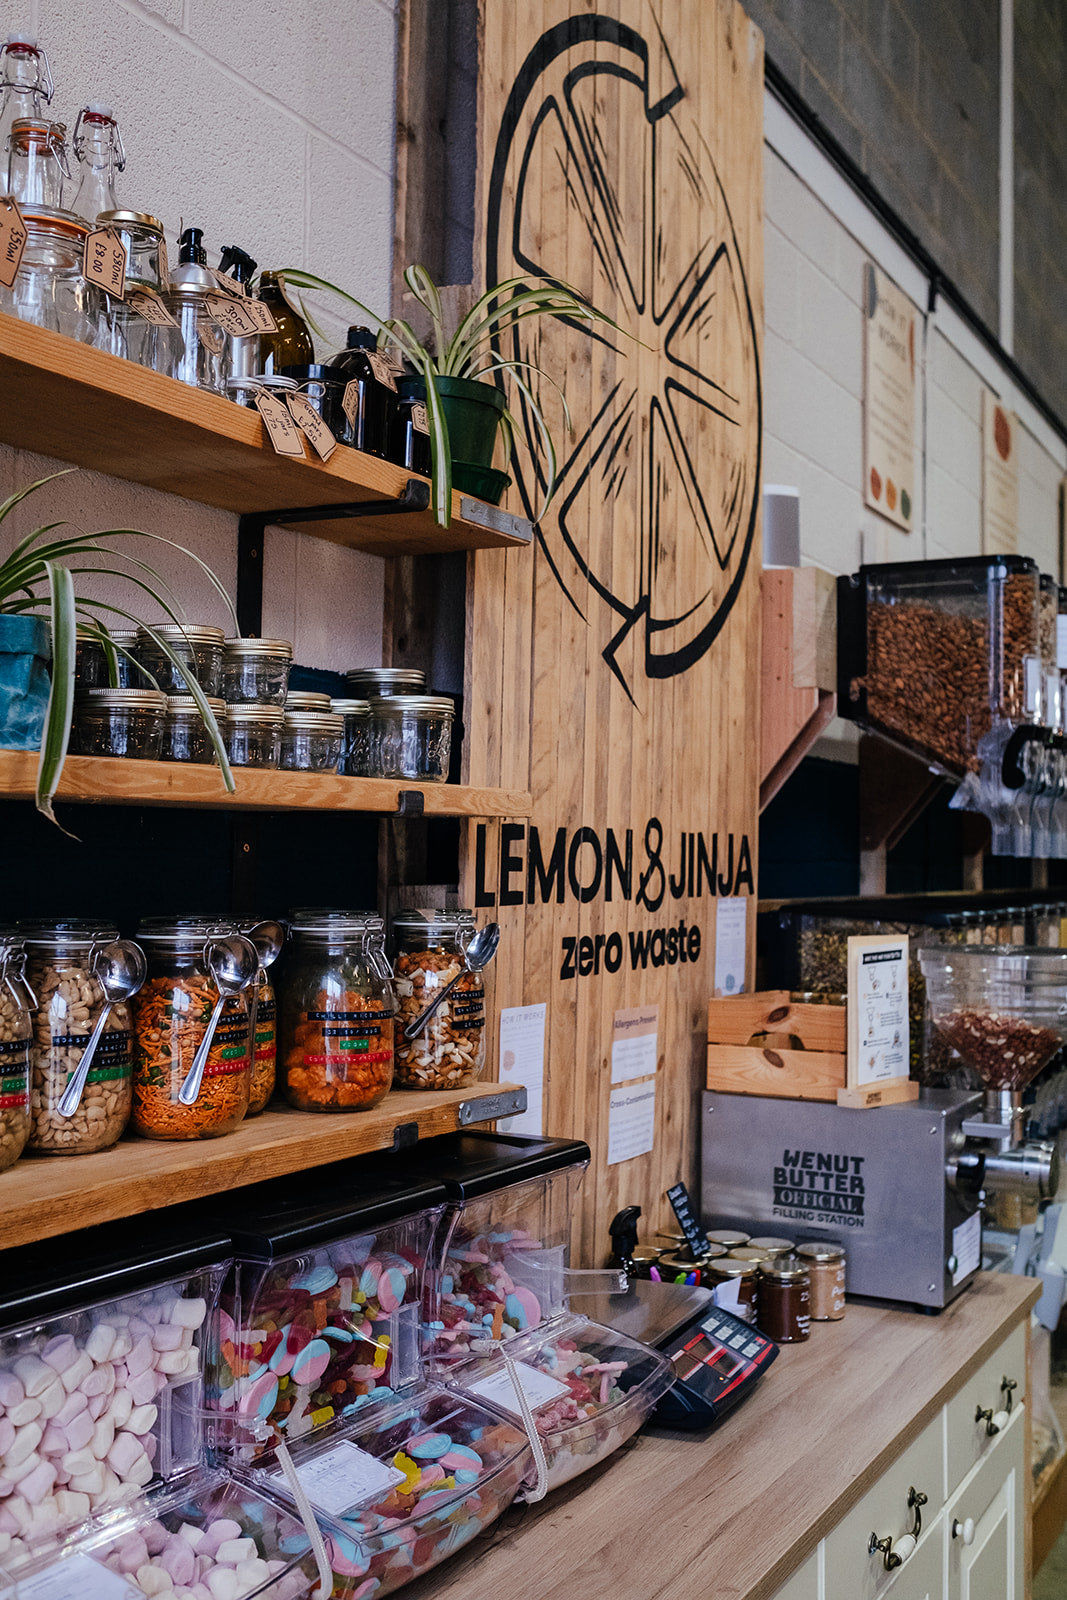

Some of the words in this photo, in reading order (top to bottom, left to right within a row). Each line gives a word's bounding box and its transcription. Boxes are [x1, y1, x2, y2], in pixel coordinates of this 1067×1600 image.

[92, 242, 107, 273] £8.00
[111, 250, 124, 286] 580ml
[225, 305, 249, 332] 300ml
[475, 823, 633, 908] LEMON
[636, 817, 666, 913] &
[669, 832, 755, 899] JINJA
[560, 931, 623, 981] zero
[628, 919, 701, 970] waste
[782, 1149, 866, 1175] WENUT
[773, 1166, 866, 1195] BUTTER
[779, 1189, 858, 1212] OFFICIAL
[772, 1207, 815, 1221] FILLING
[816, 1213, 865, 1228] STATION
